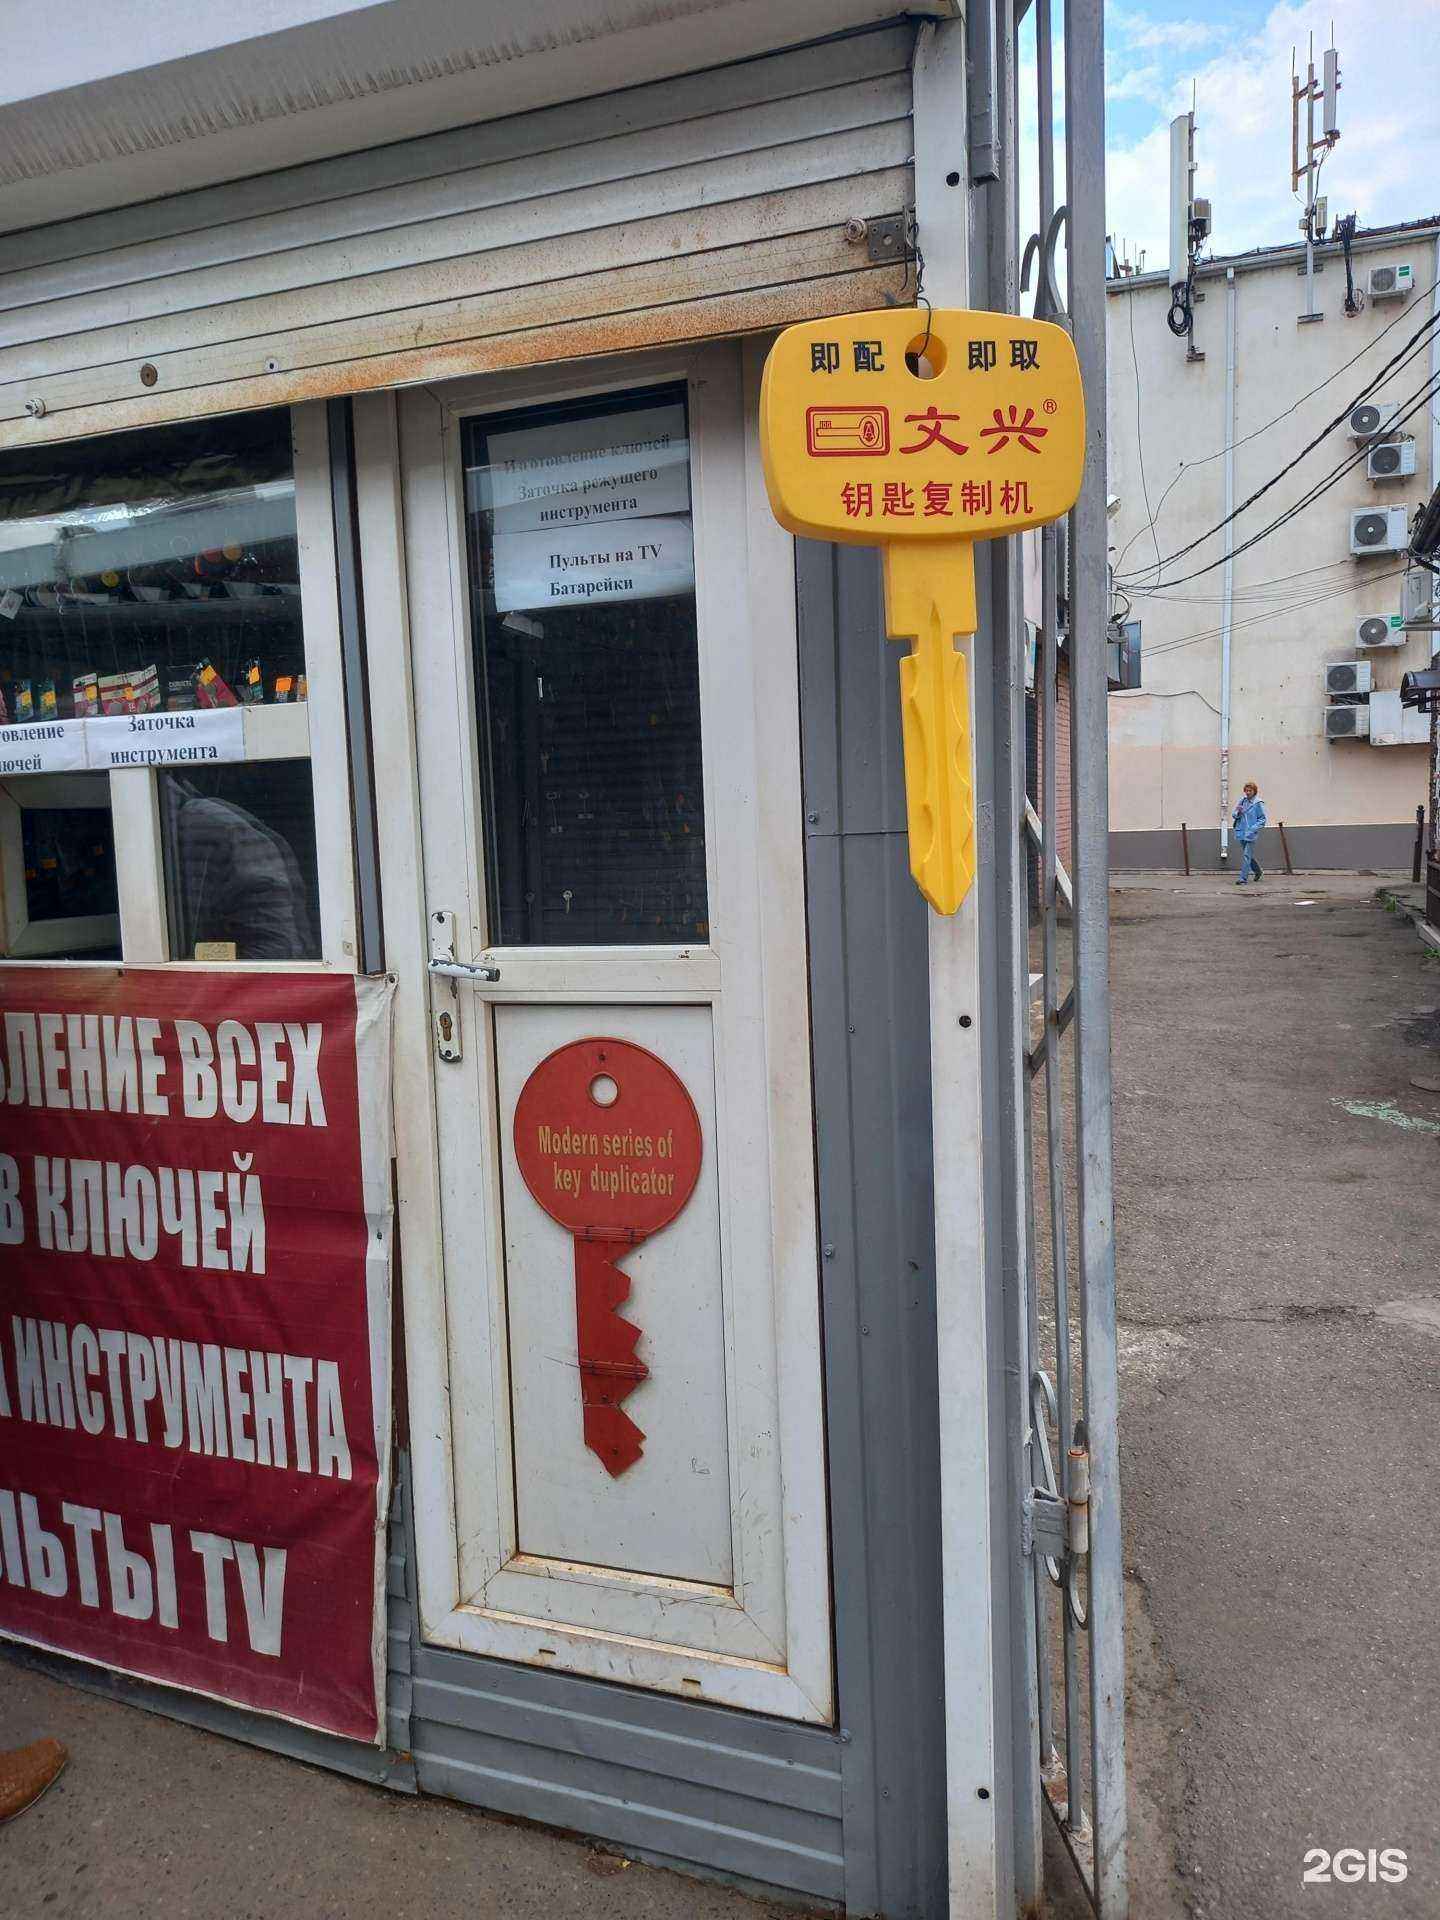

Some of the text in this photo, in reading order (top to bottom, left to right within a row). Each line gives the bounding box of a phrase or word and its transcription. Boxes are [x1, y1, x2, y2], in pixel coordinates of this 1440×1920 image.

[810, 340, 1040, 374] 即配 即取
[610, 434, 670, 455] ключей
[899, 405, 1049, 456] 文兴
[519, 479, 578, 501] Заточка
[840, 480, 1034, 517] 钥匙复制机
[540, 497, 638, 523] инструмента
[549, 543, 662, 571] Пульты на TV
[549, 576, 634, 598] Батарейки
[0, 726, 65, 742] овление
[127, 714, 196, 733] Заточка
[0, 753, 42, 772] ючей
[110, 744, 218, 767] инструмента
[0, 1012, 328, 1127] ЛЕНИЕ ВСЕХ
[538, 1125, 673, 1159] Modern series of
[554, 1161, 675, 1200] key duplicator
[34, 1150, 266, 1275] КЛЮЧЕЙ
[12, 1315, 352, 1480] ИНСТРУМЕНТА
[190, 1530, 287, 1658] TV
